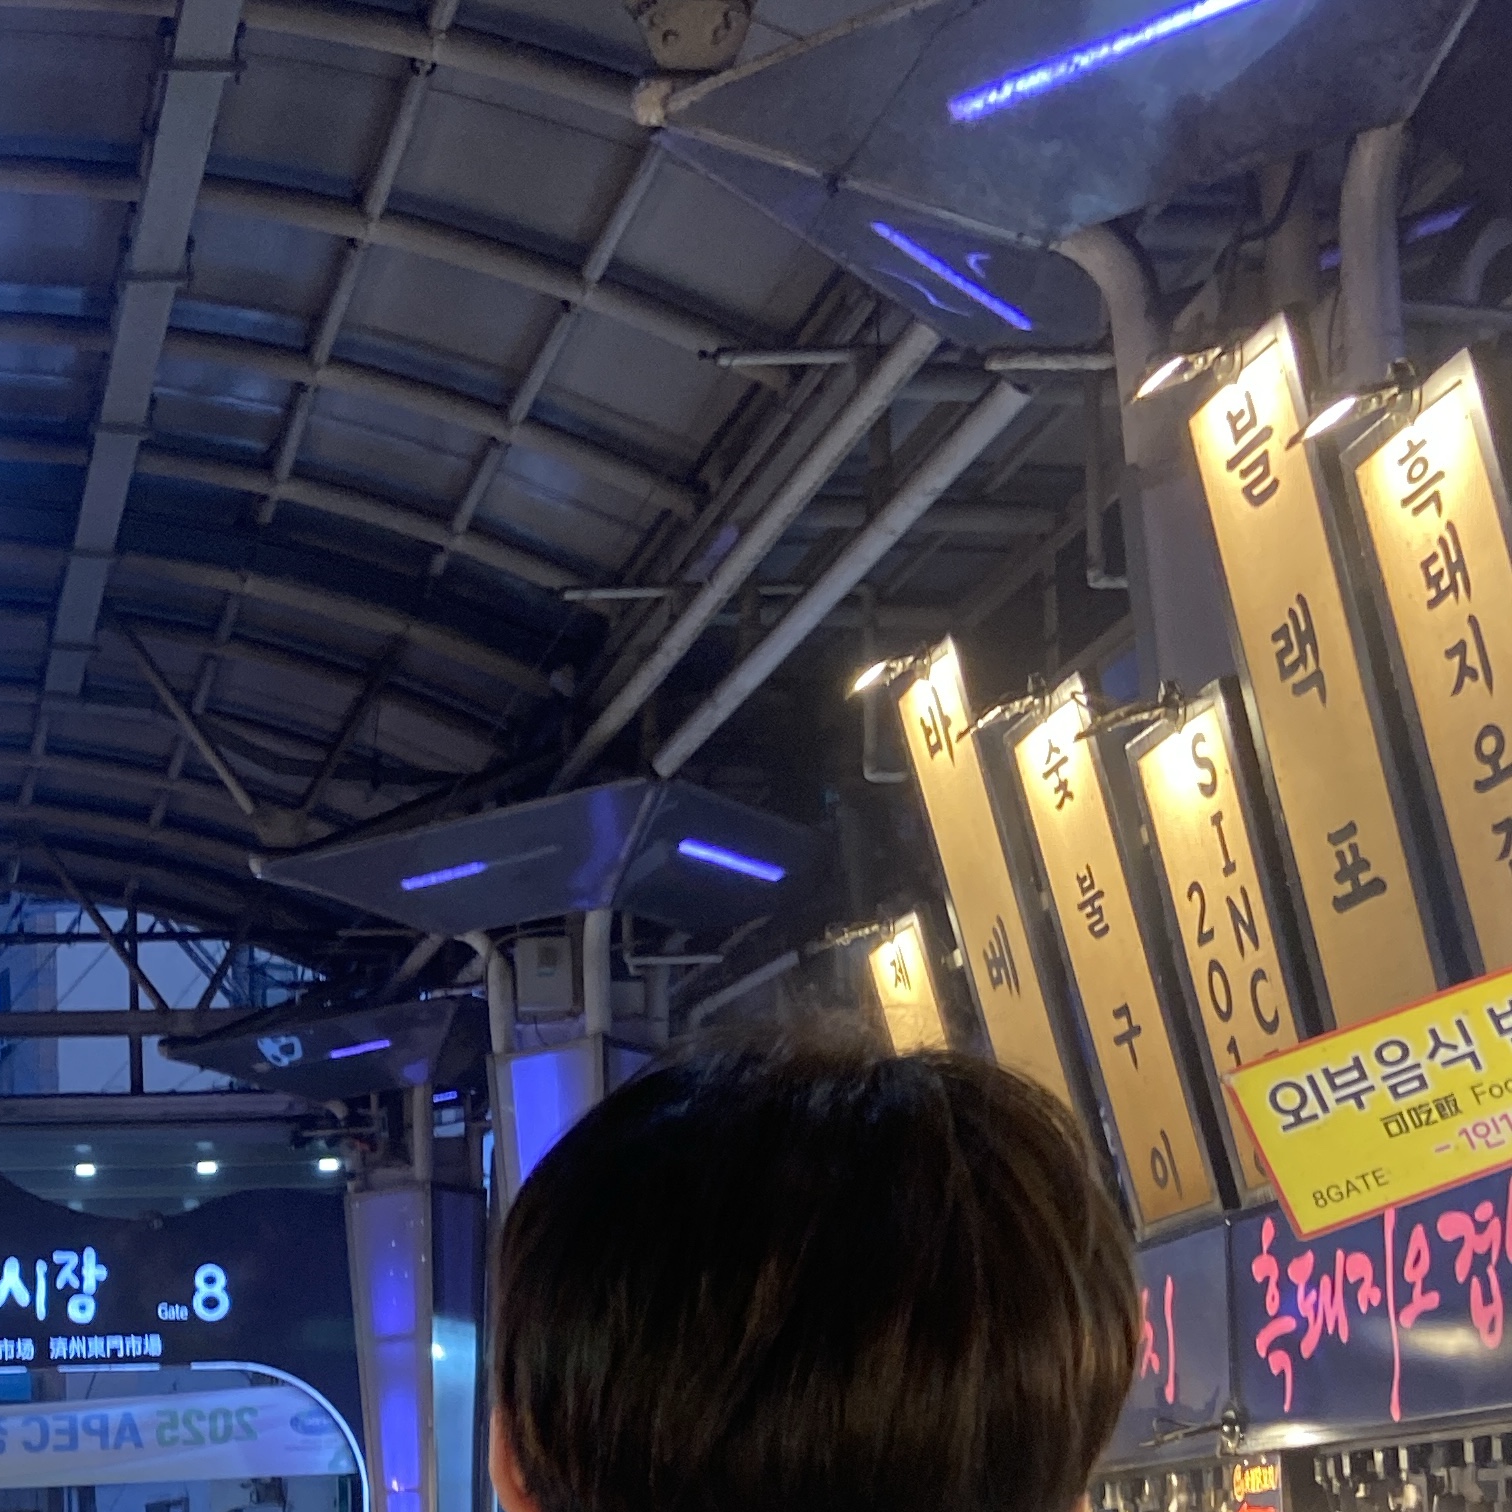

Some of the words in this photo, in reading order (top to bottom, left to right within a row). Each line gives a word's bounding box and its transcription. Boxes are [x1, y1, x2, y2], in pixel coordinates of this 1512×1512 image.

[1226, 390, 1387, 913] 블랙포
[919, 685, 1022, 997] 바베
[1041, 739, 1183, 1197] 숯불구이
[1191, 733, 1280, 1036] SINC
[1268, 1018, 1483, 1133] 외부음식
[1312, 1167, 1390, 1209] 8GATE
[193, 1263, 230, 1322] 8
[1251, 1180, 1512, 1422] 흑돼지오겹
